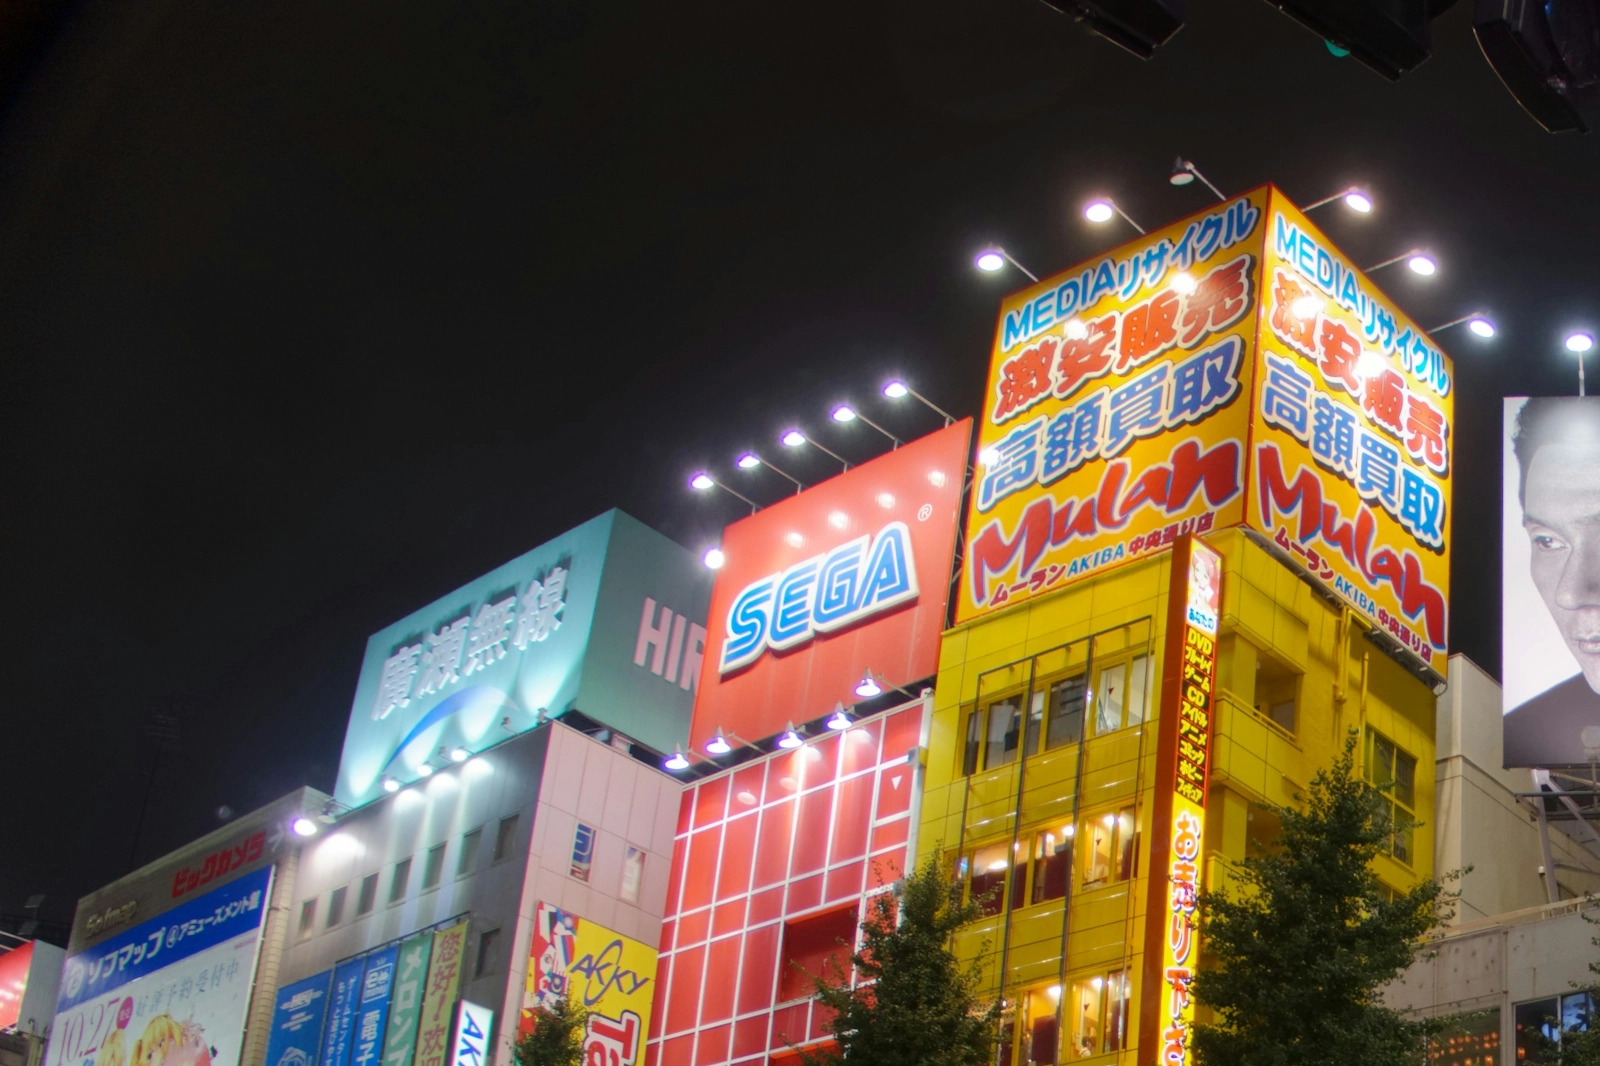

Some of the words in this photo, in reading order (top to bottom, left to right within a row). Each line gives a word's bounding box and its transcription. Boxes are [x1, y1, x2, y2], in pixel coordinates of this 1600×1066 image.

[1002, 199, 1258, 352] MEDIAリサイクル
[1276, 216, 1449, 396] MEDIAリサイクル
[992, 255, 1250, 423] 激安販売
[1270, 268, 1449, 473] 激安販売
[978, 335, 1241, 511] 高額買取
[1262, 352, 1444, 553] 高額買取
[970, 440, 1239, 606] Mulan
[1257, 441, 1447, 650] Mulan
[990, 563, 1066, 607] ムーラン
[1069, 545, 1125, 577] AKIBA
[1129, 511, 1214, 556] 中央通り店
[720, 521, 919, 672] SEGA
[1274, 528, 1334, 582] ムーラン
[1335, 579, 1376, 619] AKIBA
[1378, 608, 1432, 663] 中央通り店
[1185, 645, 1212, 674] ブルーレイ
[1187, 627, 1212, 655] DVD
[1184, 662, 1211, 693] ゲーム
[1186, 685, 1205, 708] CD
[1179, 718, 1207, 746] アニメ
[1182, 700, 1208, 729] アイドル
[1179, 740, 1205, 764] コミック
[1179, 759, 1203, 782] ホビー
[1177, 776, 1203, 803] フィギュア
[172, 831, 266, 898] ビックカメラ
[89, 927, 165, 984] ソフマップ
[56, 997, 121, 1066] 10.27
